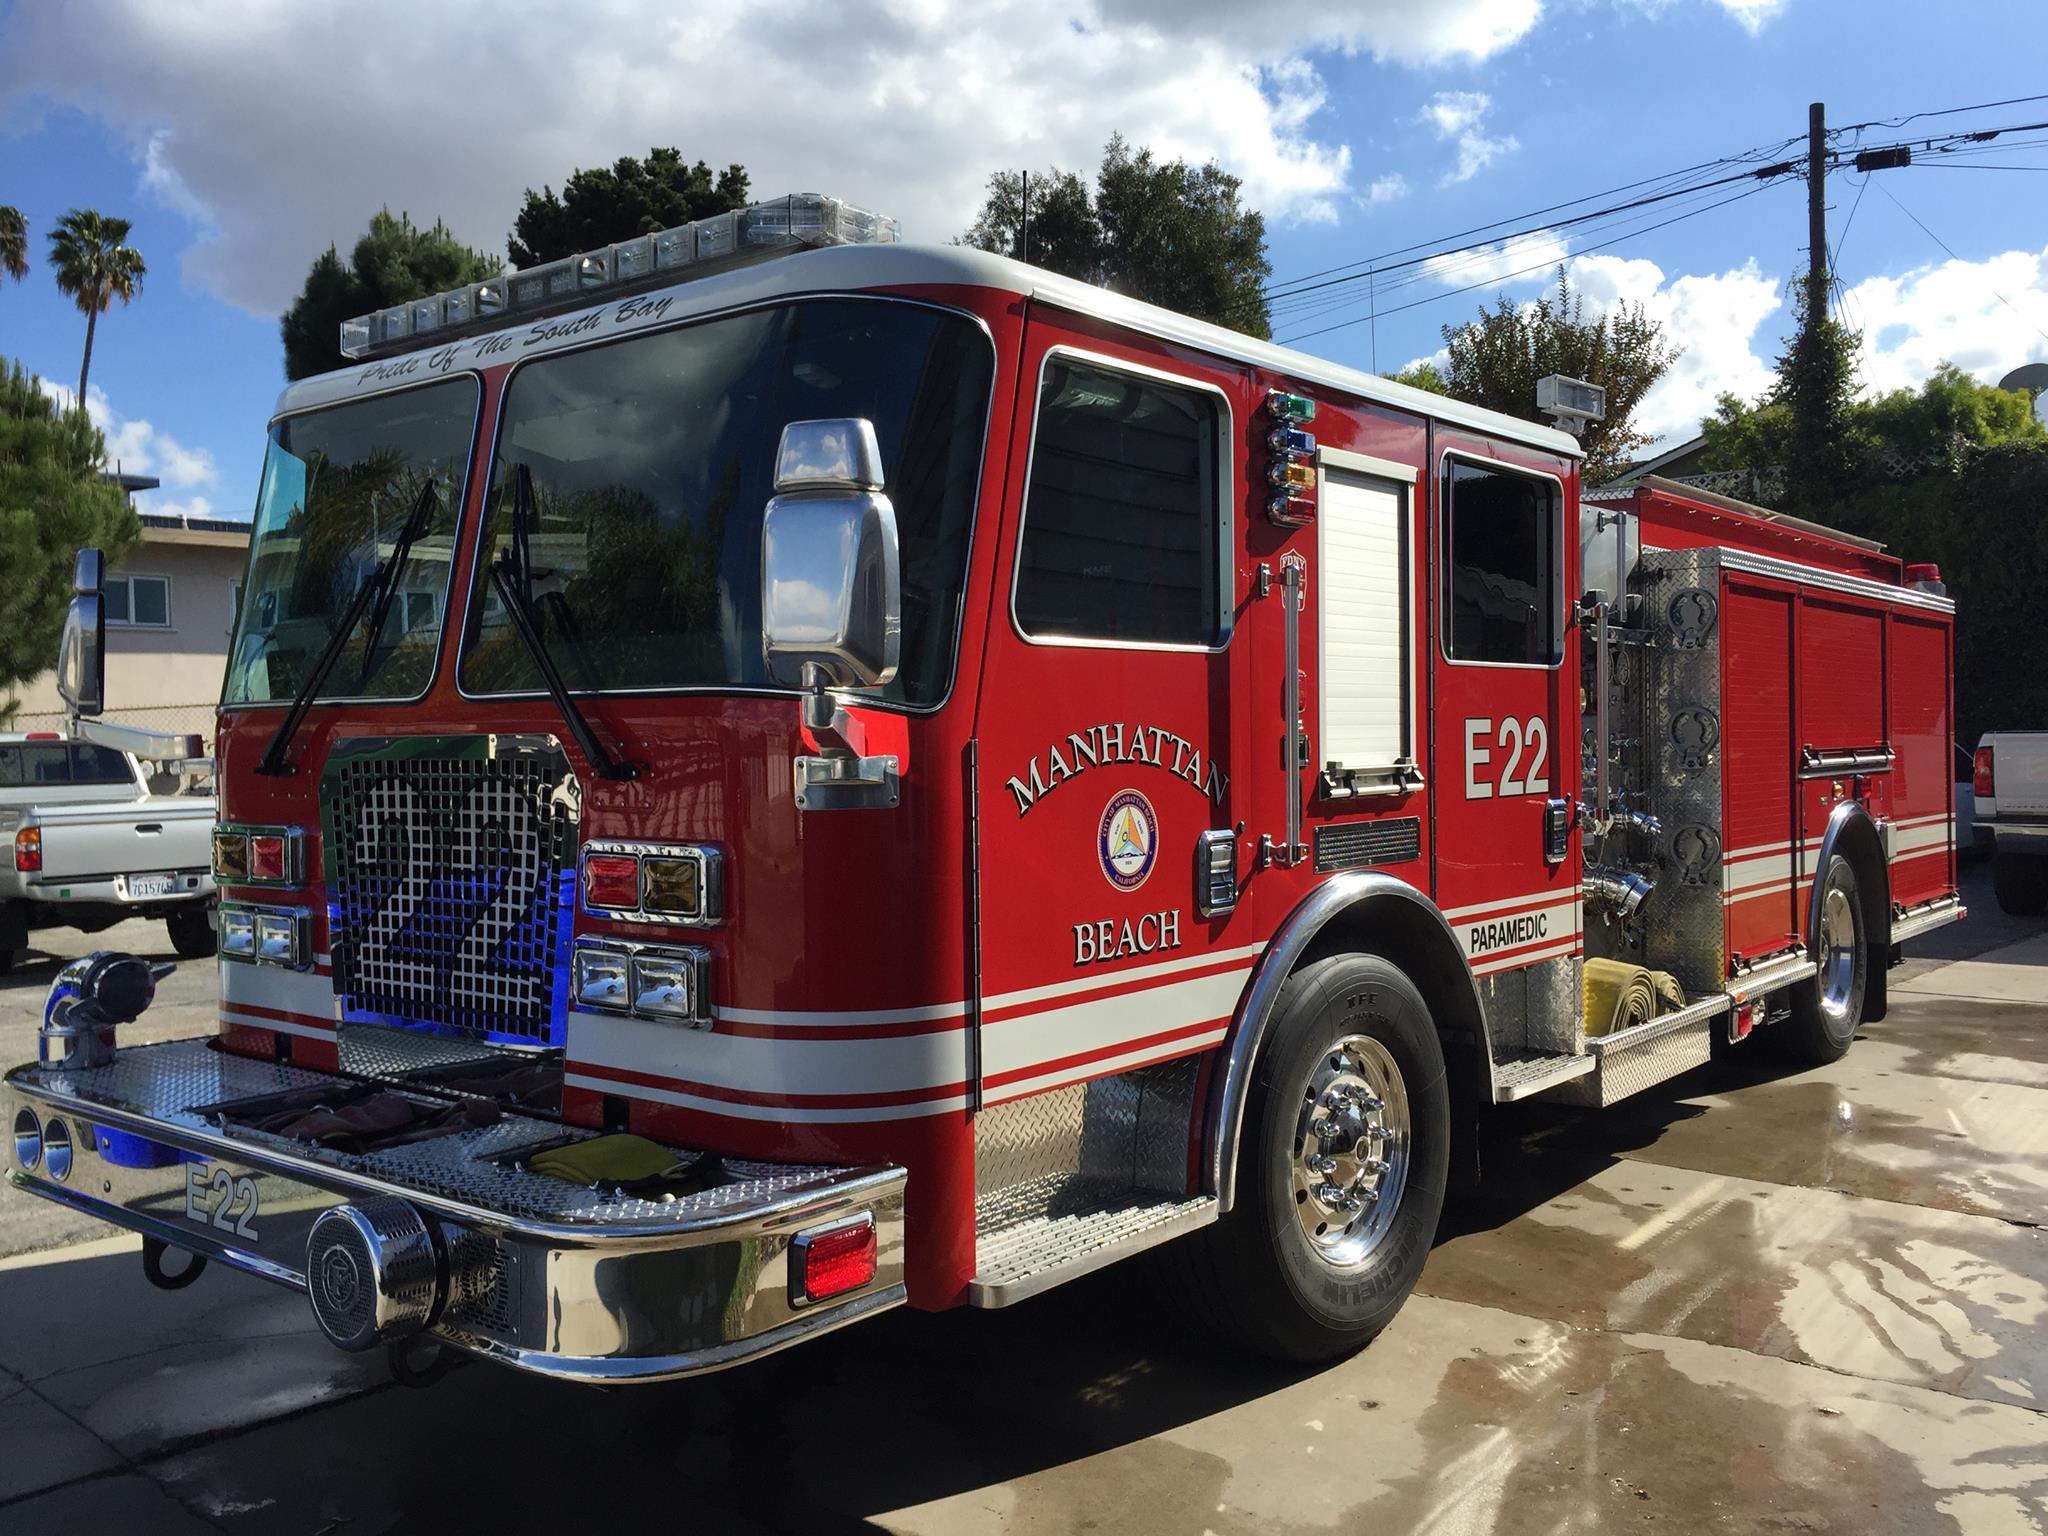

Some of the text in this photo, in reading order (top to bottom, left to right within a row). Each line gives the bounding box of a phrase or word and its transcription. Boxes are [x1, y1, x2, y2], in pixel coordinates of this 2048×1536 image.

[357, 294, 675, 386] Pride Of The South Bay
[1005, 723, 1230, 820] MANHATTAN
[1464, 715, 1550, 800] E22
[1102, 815, 1111, 837] CITY
[354, 776, 542, 1018] 22
[1072, 908, 1182, 966] BEACH
[1471, 912, 1547, 953] PARAMEDIC
[184, 1160, 260, 1243] E22
